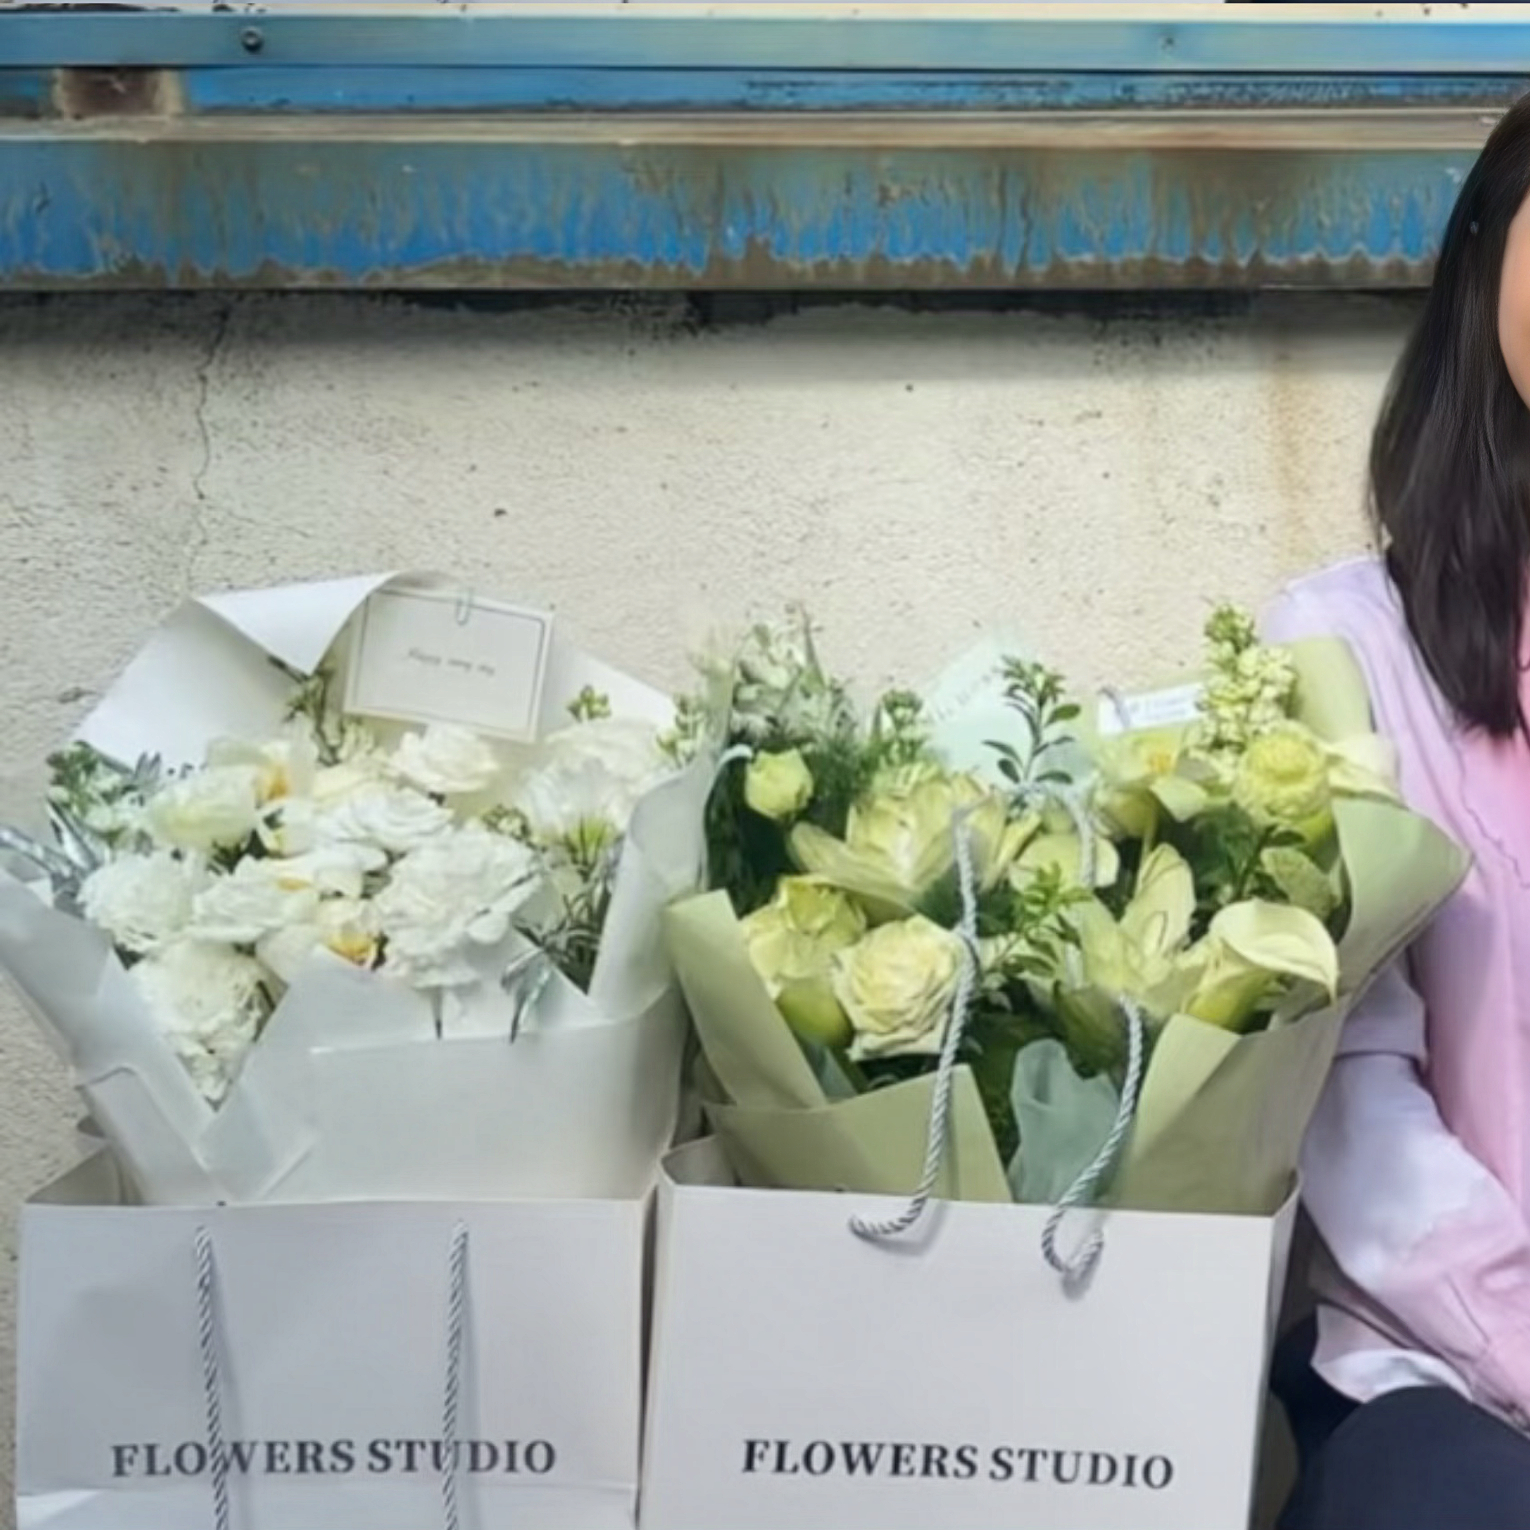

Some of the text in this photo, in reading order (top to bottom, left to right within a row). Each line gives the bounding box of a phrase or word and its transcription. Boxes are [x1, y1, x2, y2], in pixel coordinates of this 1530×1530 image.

[110, 1439, 557, 1478] FLOWERS STUDIO
[741, 1438, 1174, 1490] FLOWERS STUDIO
